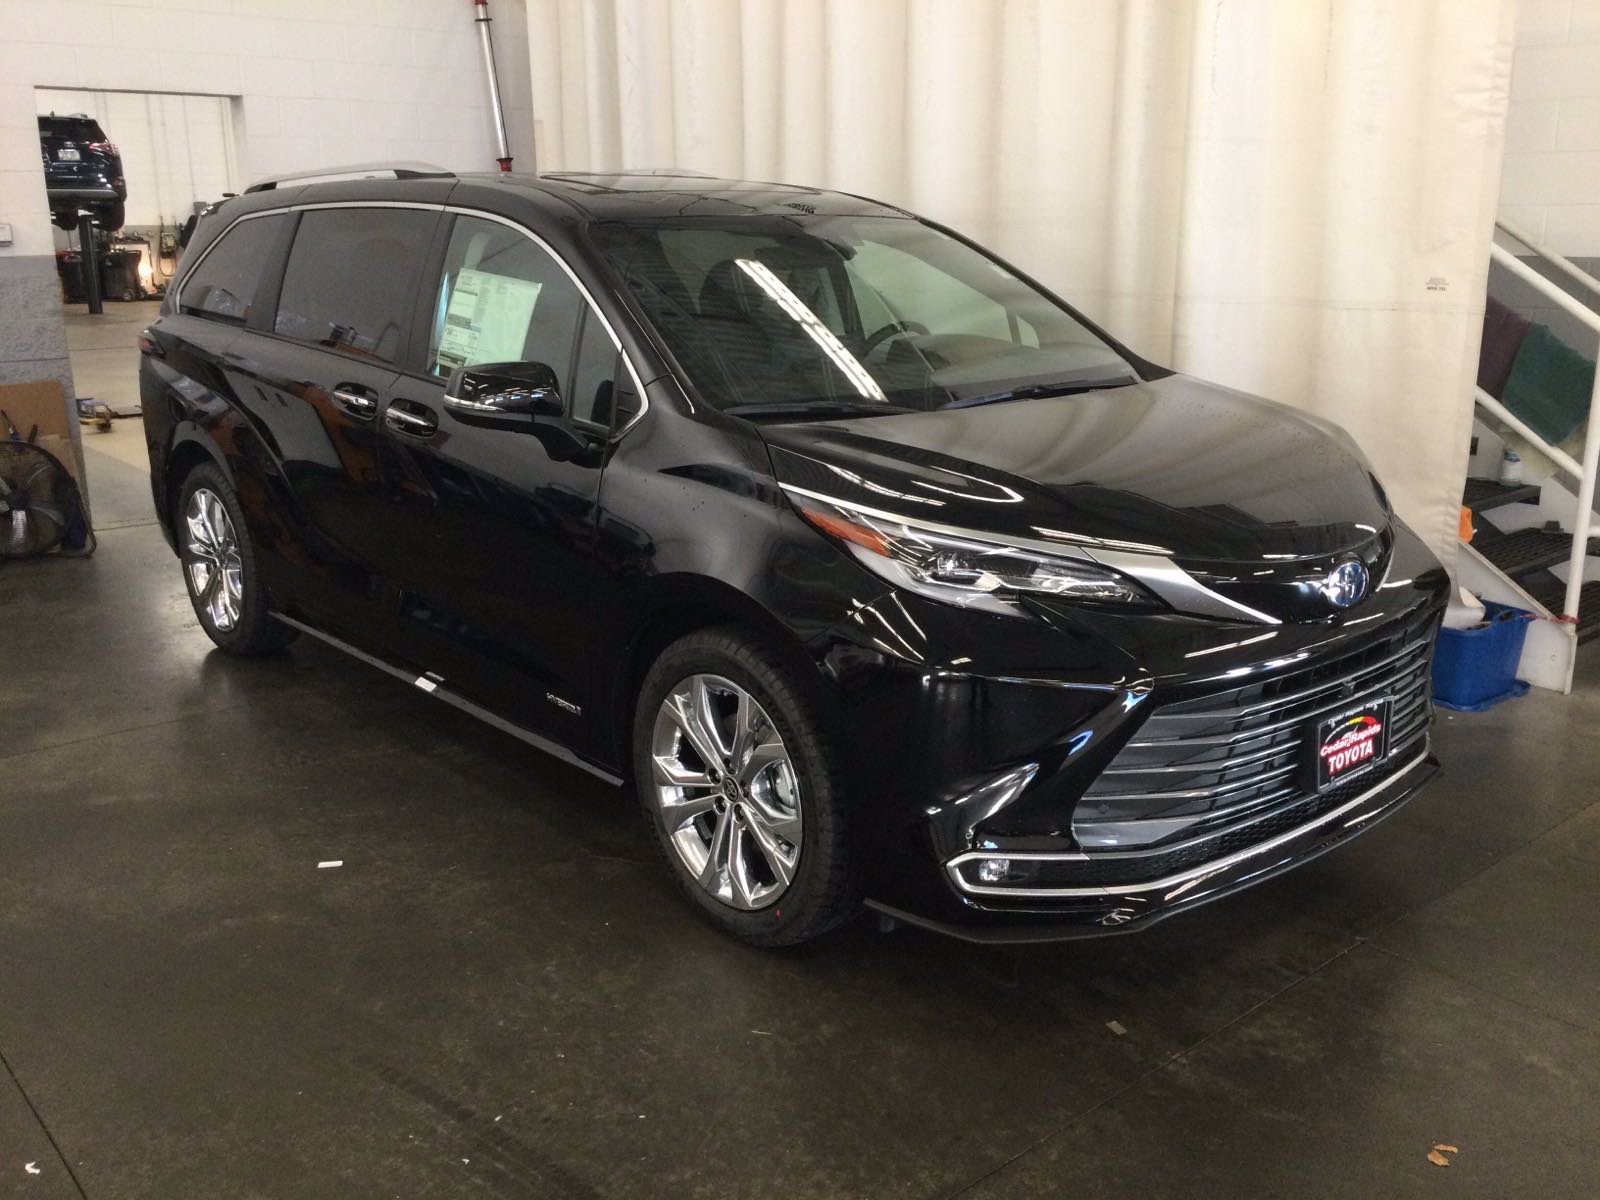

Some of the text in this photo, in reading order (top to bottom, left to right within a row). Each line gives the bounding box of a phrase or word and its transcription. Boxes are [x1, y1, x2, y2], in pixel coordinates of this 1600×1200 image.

[1321, 724, 1381, 757] Cedar Rapids
[1328, 740, 1373, 773] TOYOTA
